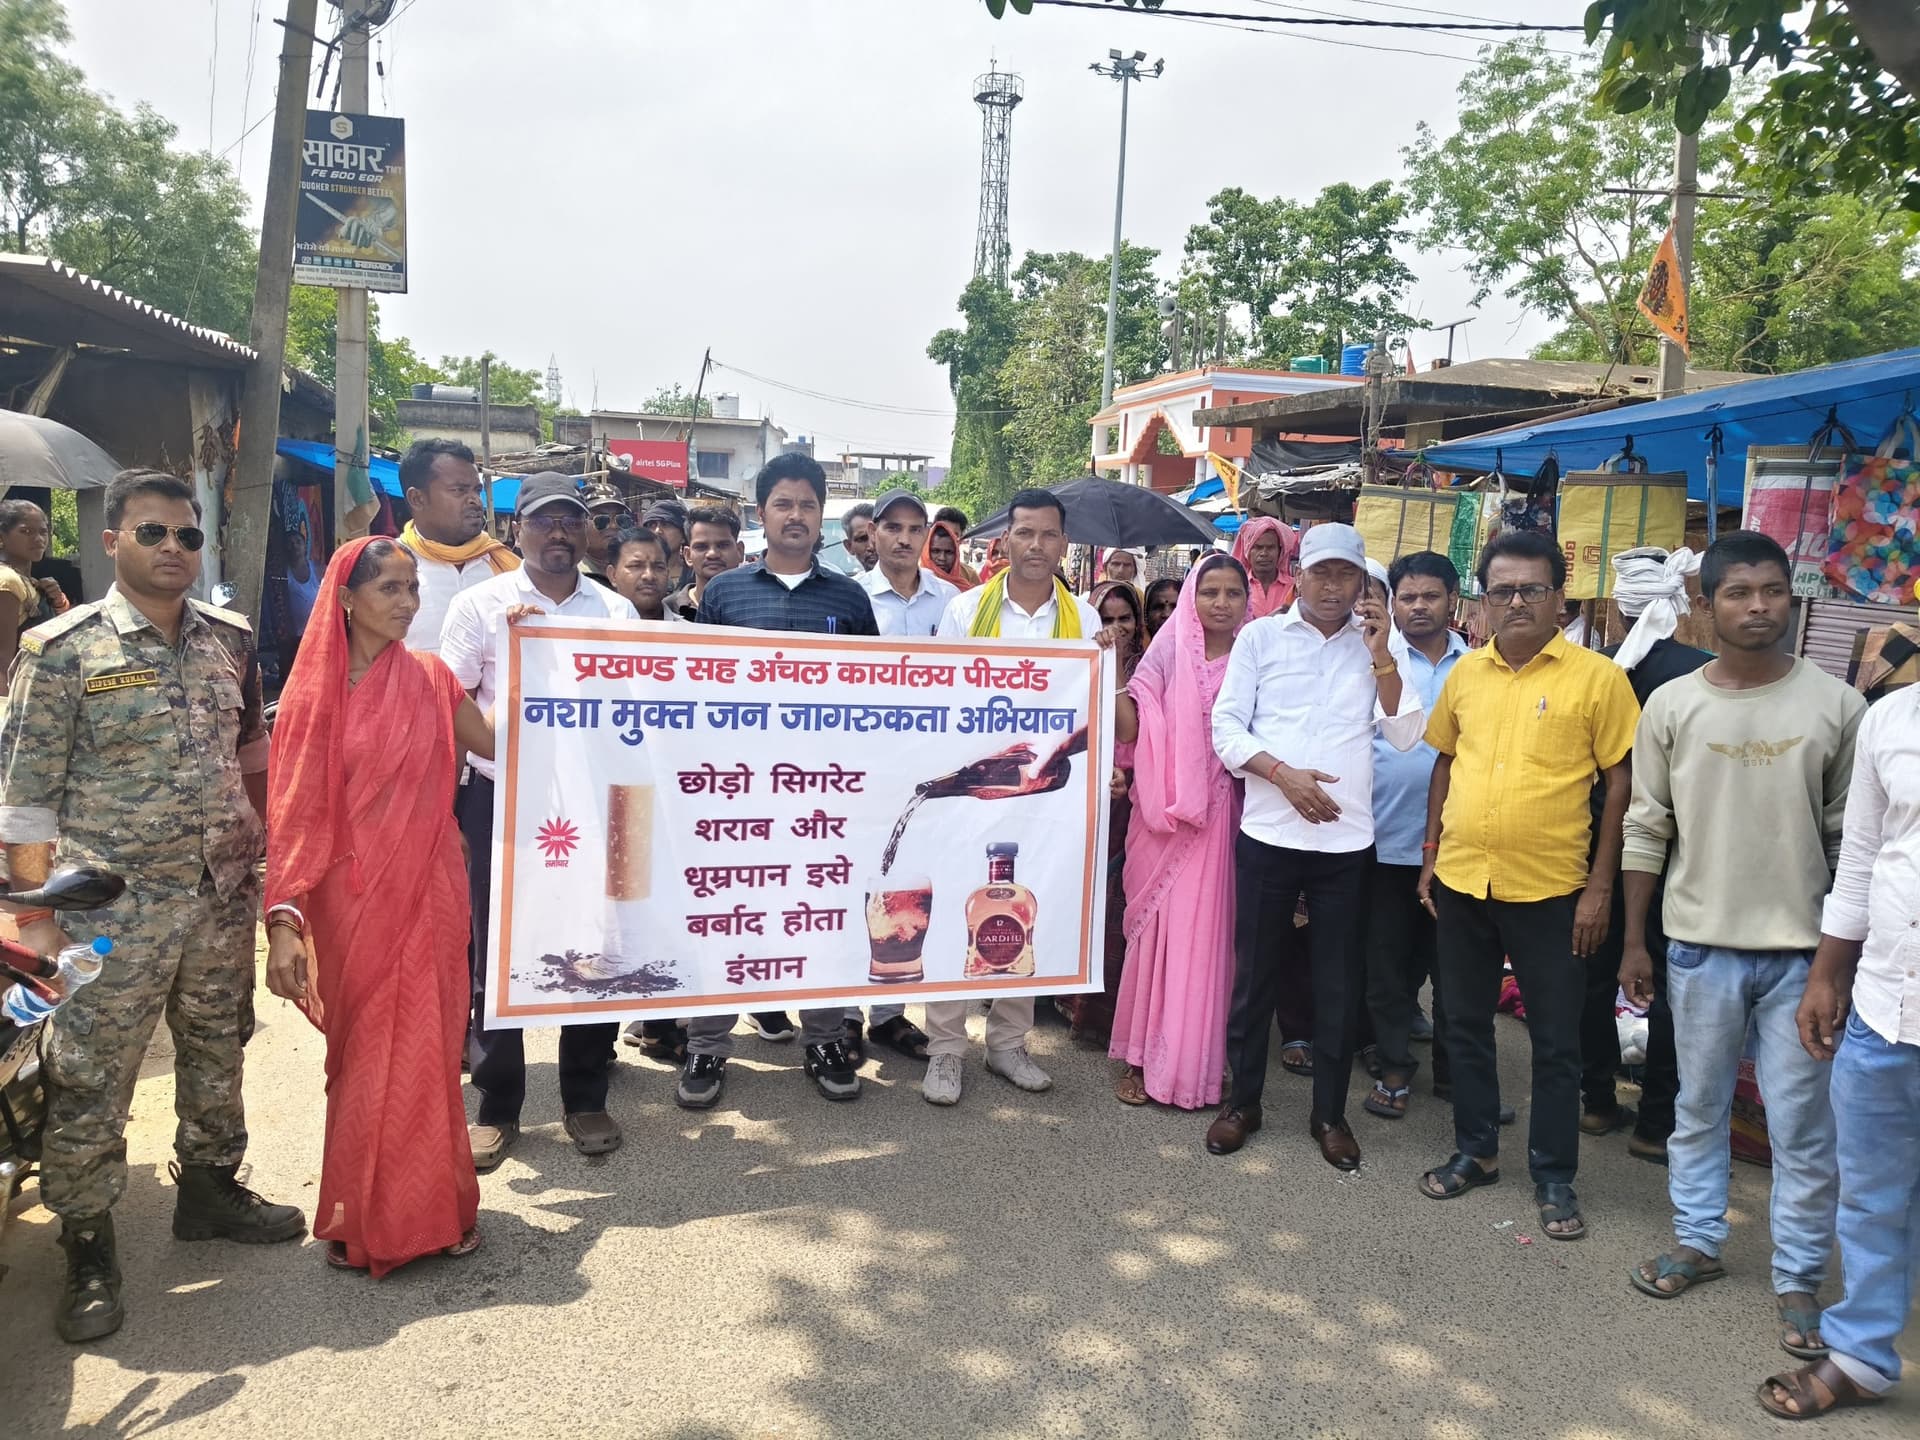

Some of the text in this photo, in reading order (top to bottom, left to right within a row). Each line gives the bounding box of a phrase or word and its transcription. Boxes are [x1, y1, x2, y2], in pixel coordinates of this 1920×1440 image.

[303, 139, 386, 172] साकार
[311, 168, 328, 177] FE
[636, 459, 655, 467] airtel
[573, 651, 1052, 692] प्रखण्ड सह अंचल कार्यालय पीरटाँड
[524, 697, 603, 728] नशा
[612, 699, 698, 746] मुक्त
[705, 701, 771, 730] जन
[956, 695, 1077, 734] अभियान
[1743, 758, 1773, 767] USPA
[677, 762, 867, 800] छोड़ो सिगरेट
[694, 809, 848, 842] शराब और
[684, 854, 854, 898] धूम्रपान इसे
[685, 901, 847, 937] बर्बाद होता
[725, 953, 807, 986] इंसान
